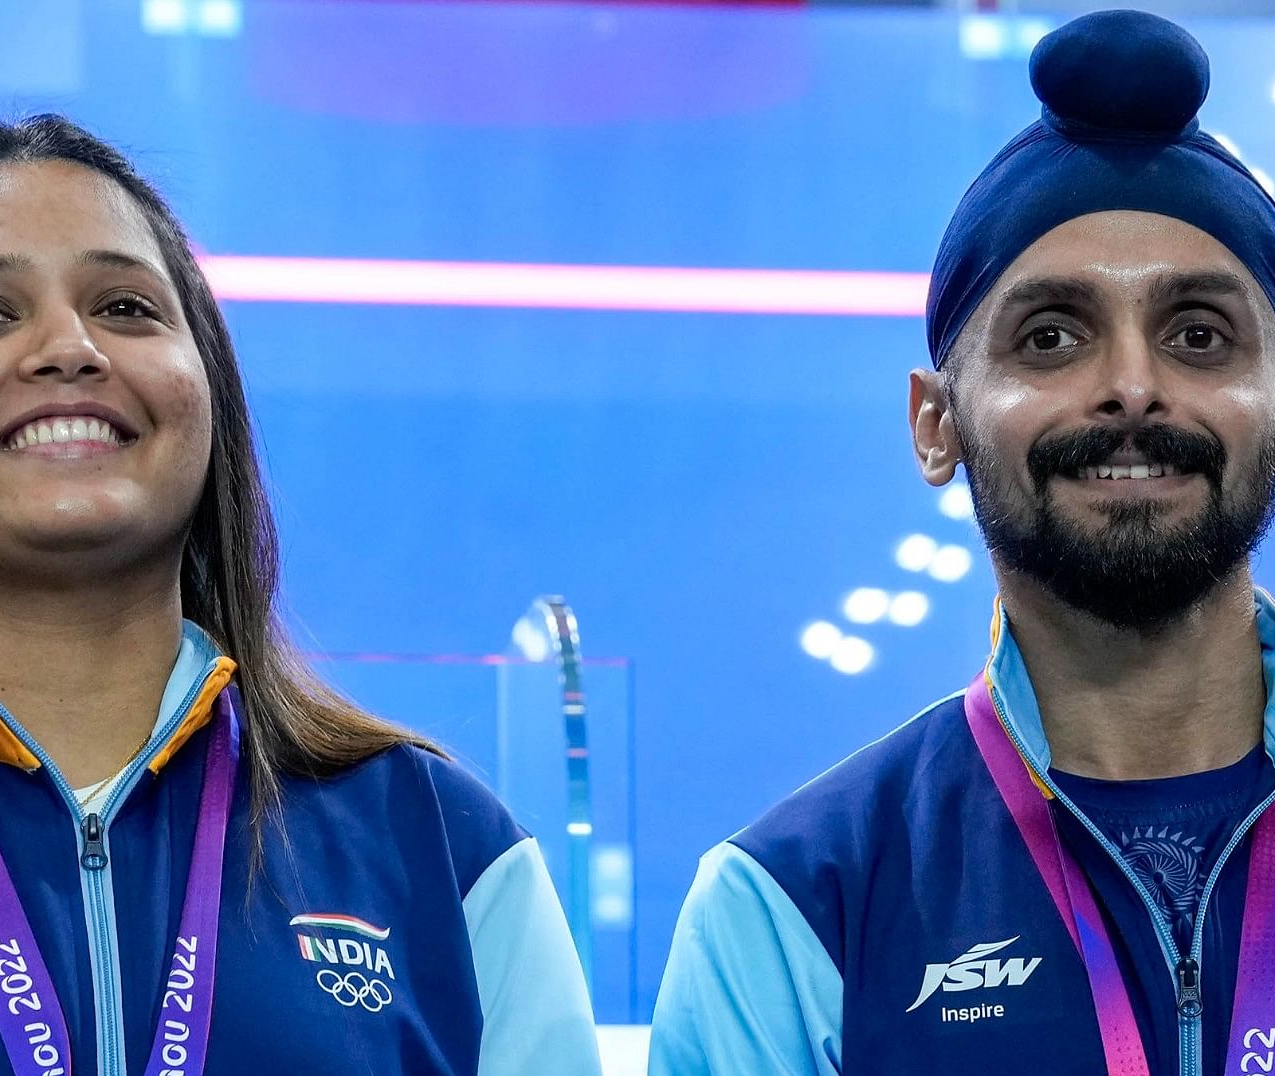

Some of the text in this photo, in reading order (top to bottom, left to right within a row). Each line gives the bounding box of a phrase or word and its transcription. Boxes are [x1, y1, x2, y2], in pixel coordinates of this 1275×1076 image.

[162, 935, 198, 1013] 2022
[297, 933, 395, 980] INDIA
[905, 957, 1043, 1013] JSW
[941, 1003, 1005, 1023] Inspire
